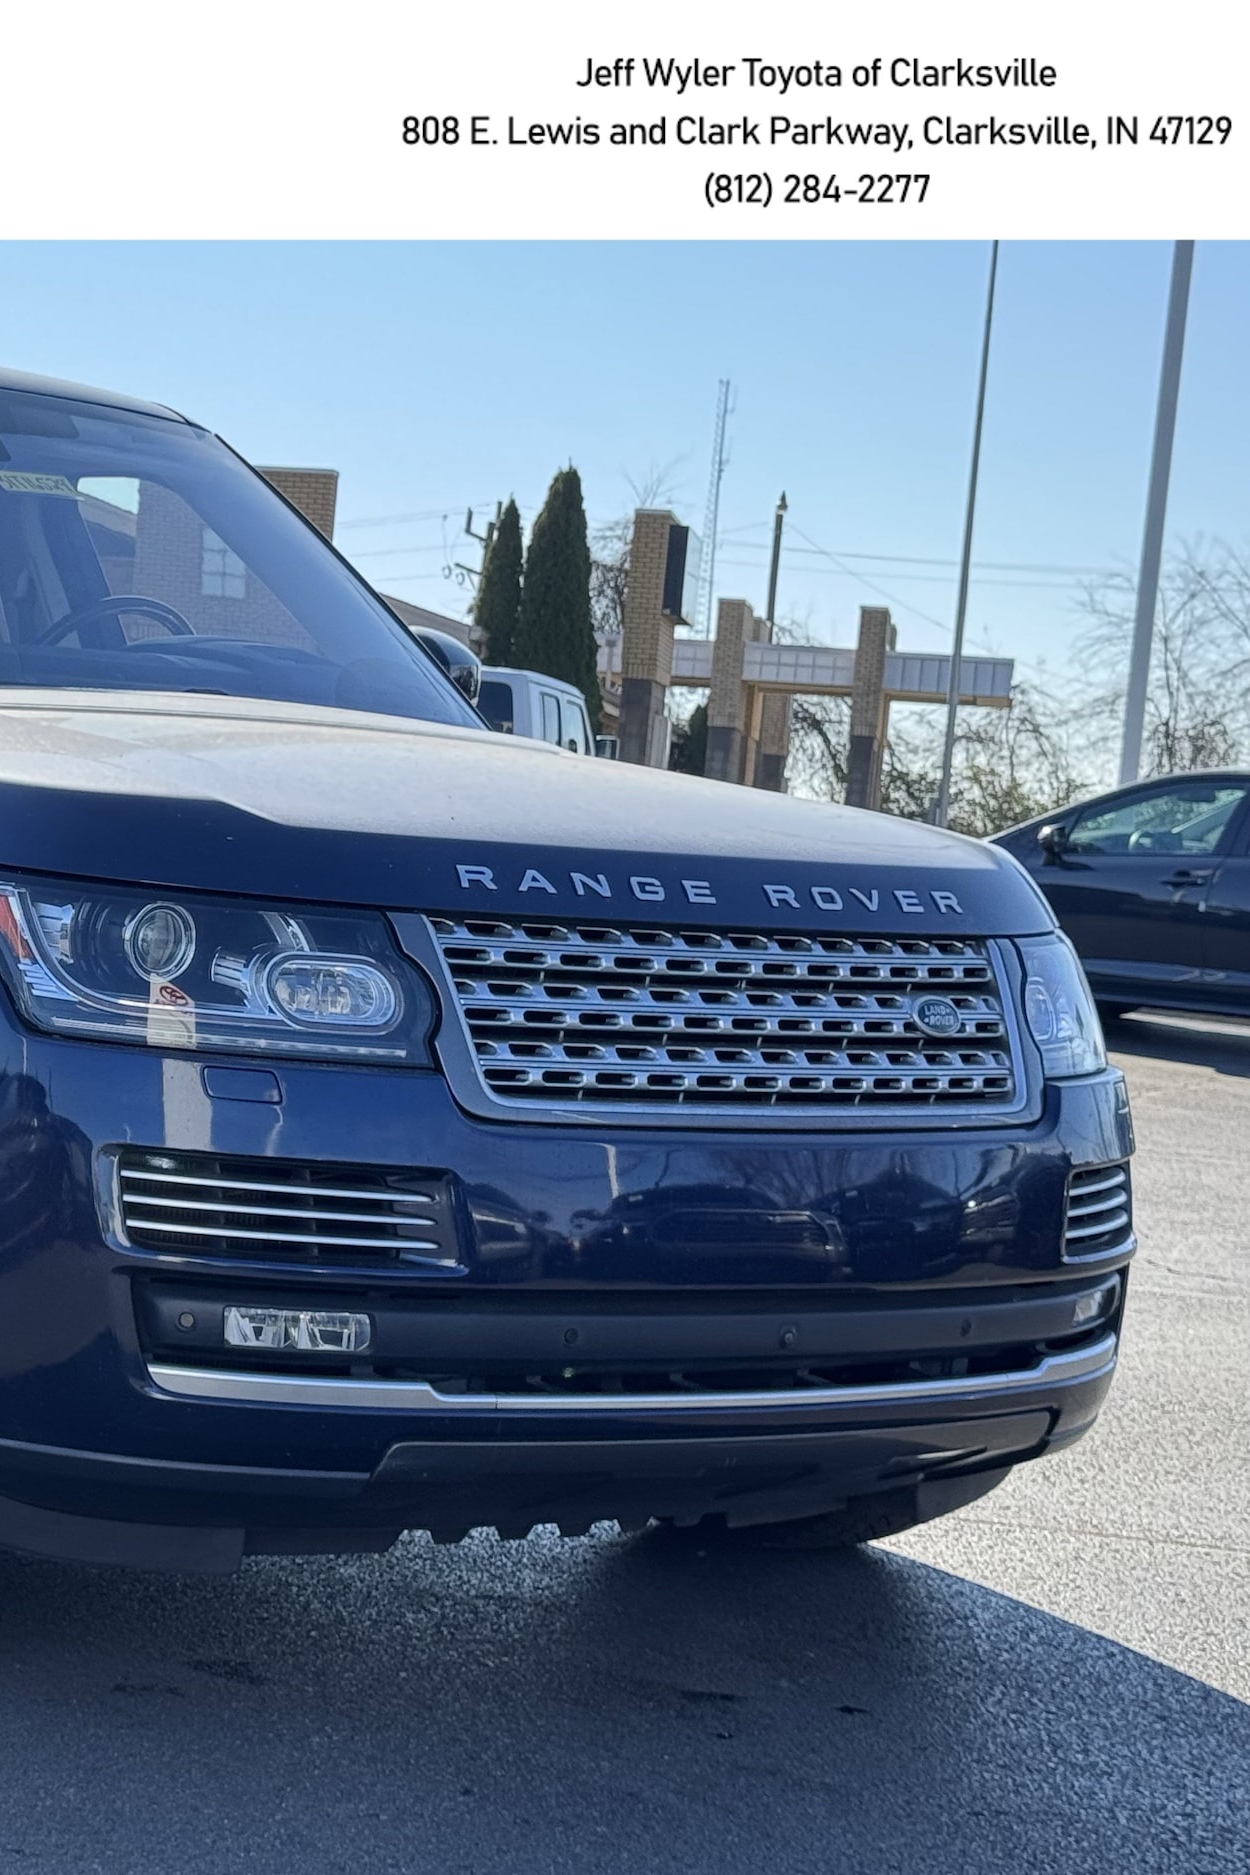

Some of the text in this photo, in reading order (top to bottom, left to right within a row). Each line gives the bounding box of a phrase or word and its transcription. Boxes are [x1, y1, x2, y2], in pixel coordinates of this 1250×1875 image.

[455, 863, 964, 914] RANGE ROVER
[924, 1004, 946, 1016] LAND
[929, 1015, 954, 1026] ROVER
